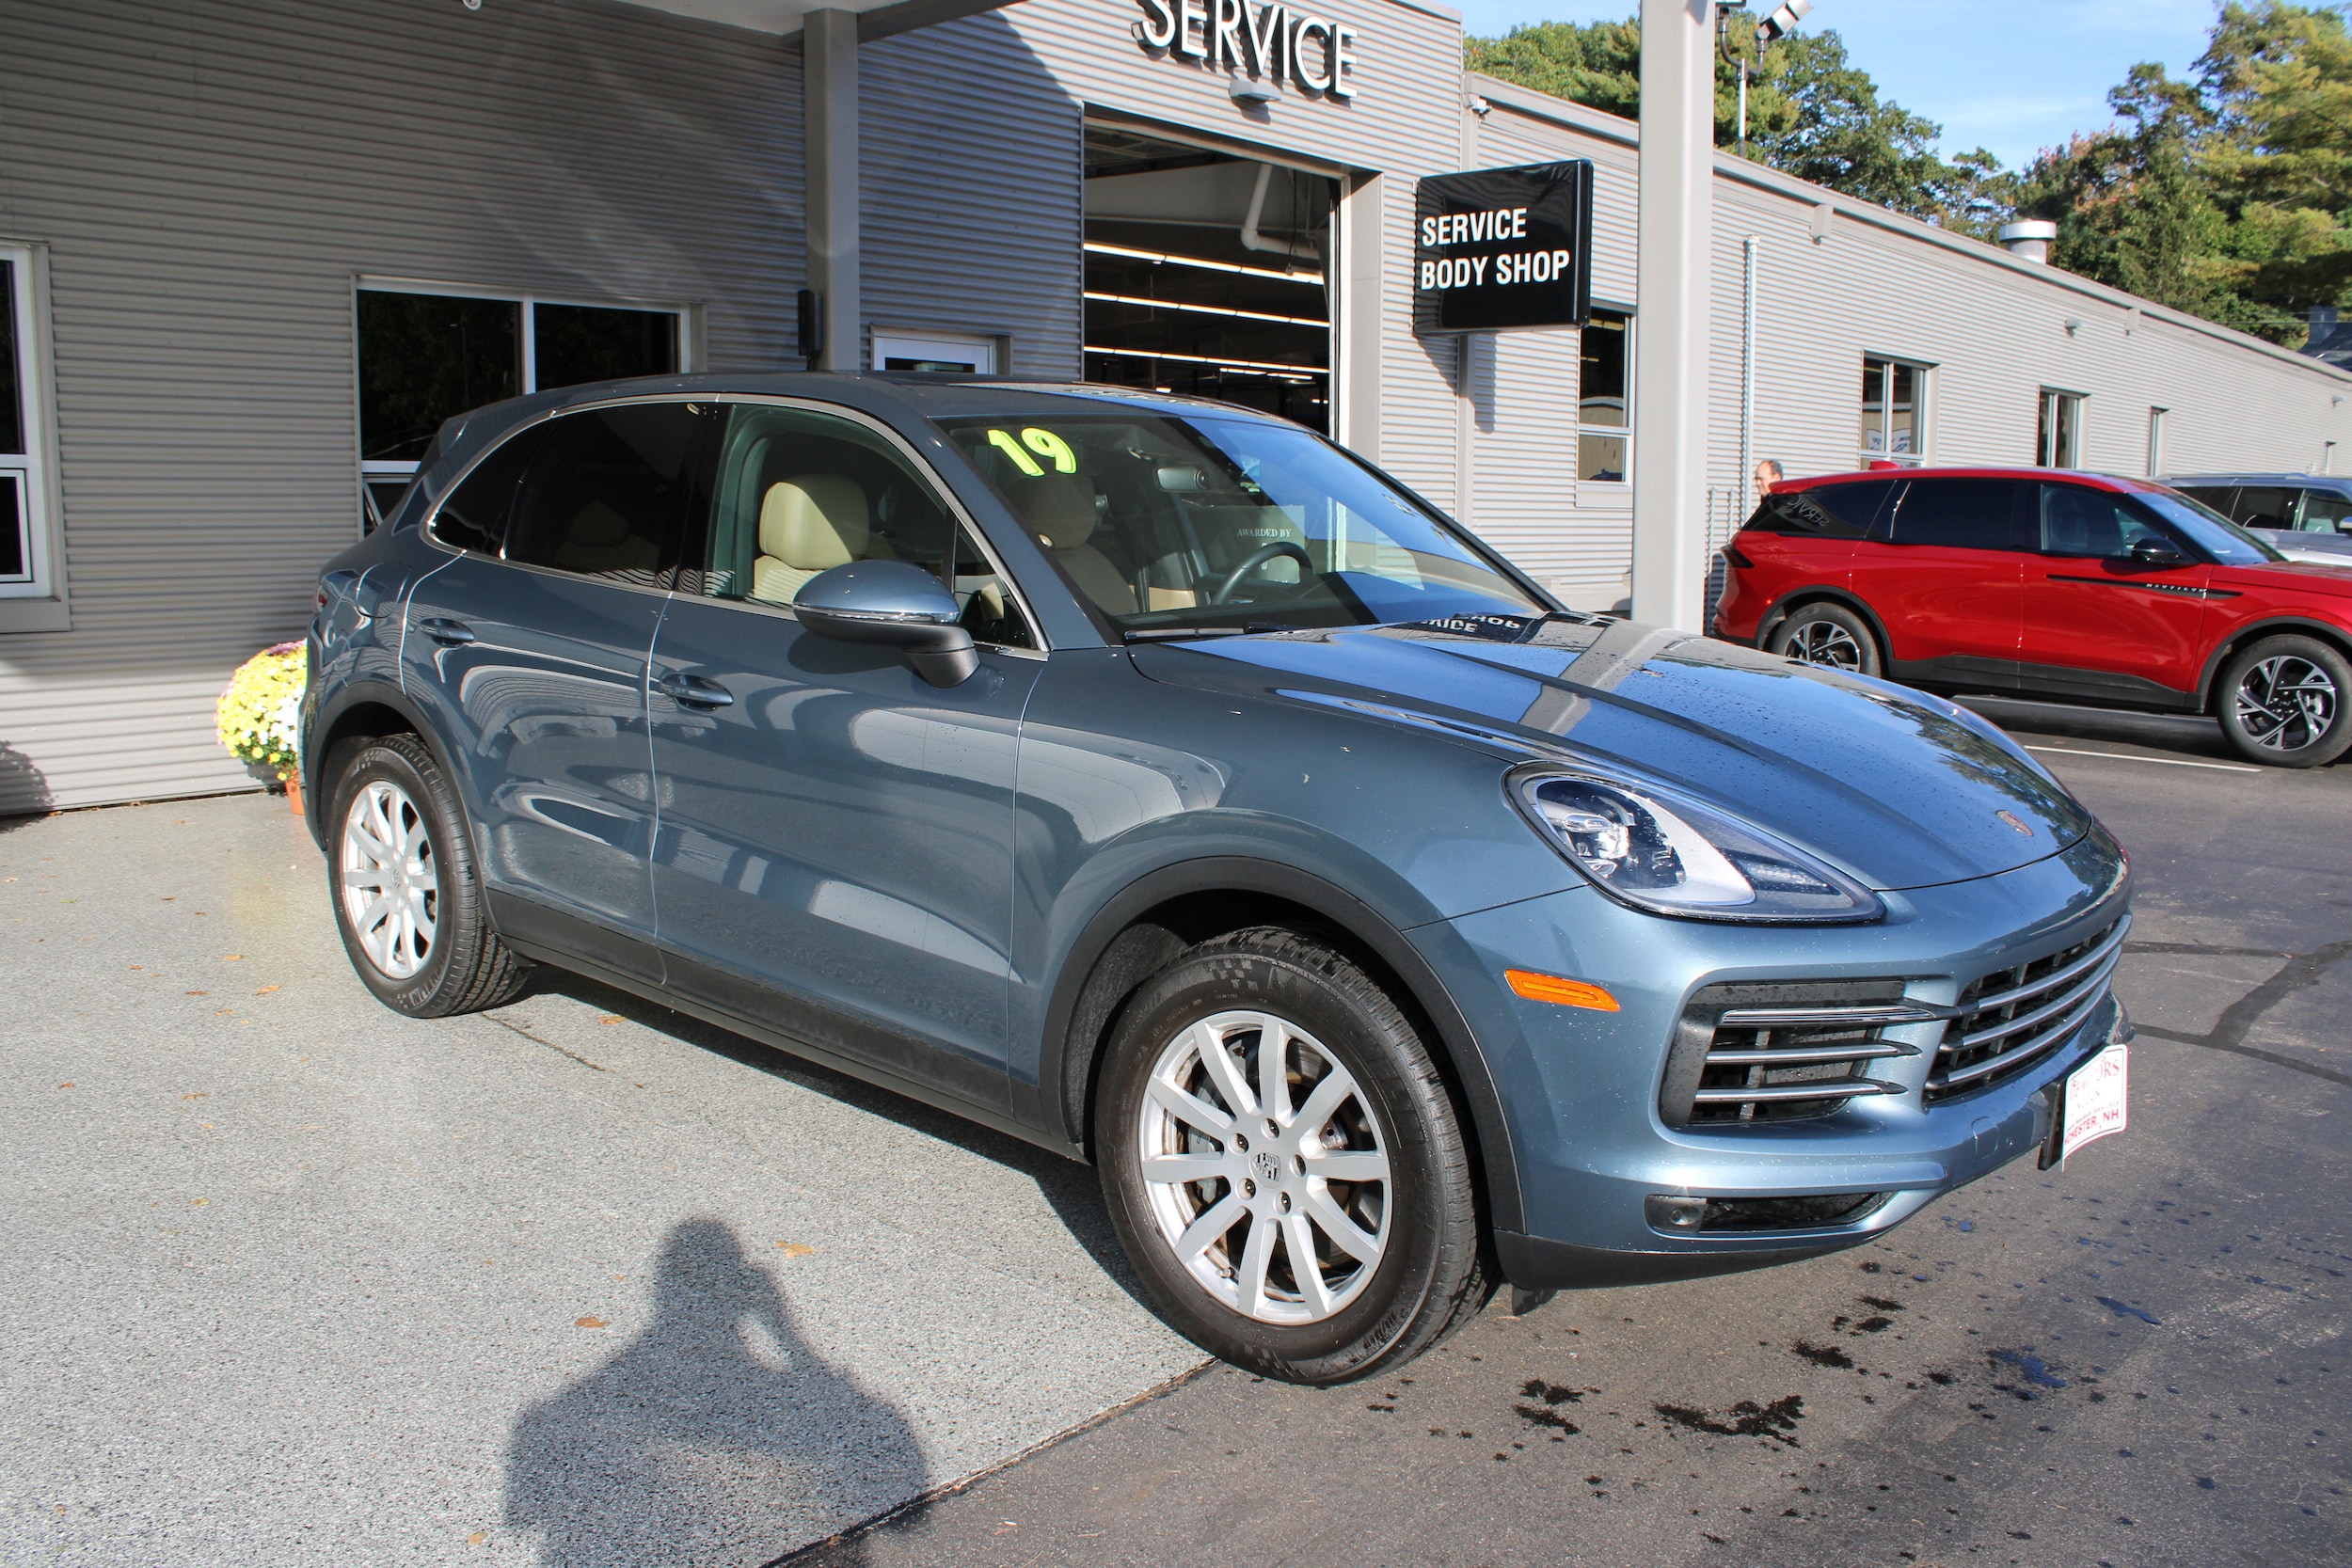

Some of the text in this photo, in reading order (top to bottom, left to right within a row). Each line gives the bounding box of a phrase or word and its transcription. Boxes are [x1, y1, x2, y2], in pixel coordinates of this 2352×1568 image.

[1133, 0, 1358, 98] SERVICE
[1422, 207, 1528, 246] SERVICE
[1421, 249, 1570, 290] BODY SHOP
[988, 427, 1077, 476] 19
[1236, 529, 1292, 538] AWARDED BY
[2146, 582, 2204, 594] NAUTILUS
[2103, 1109, 2120, 1122] NH
